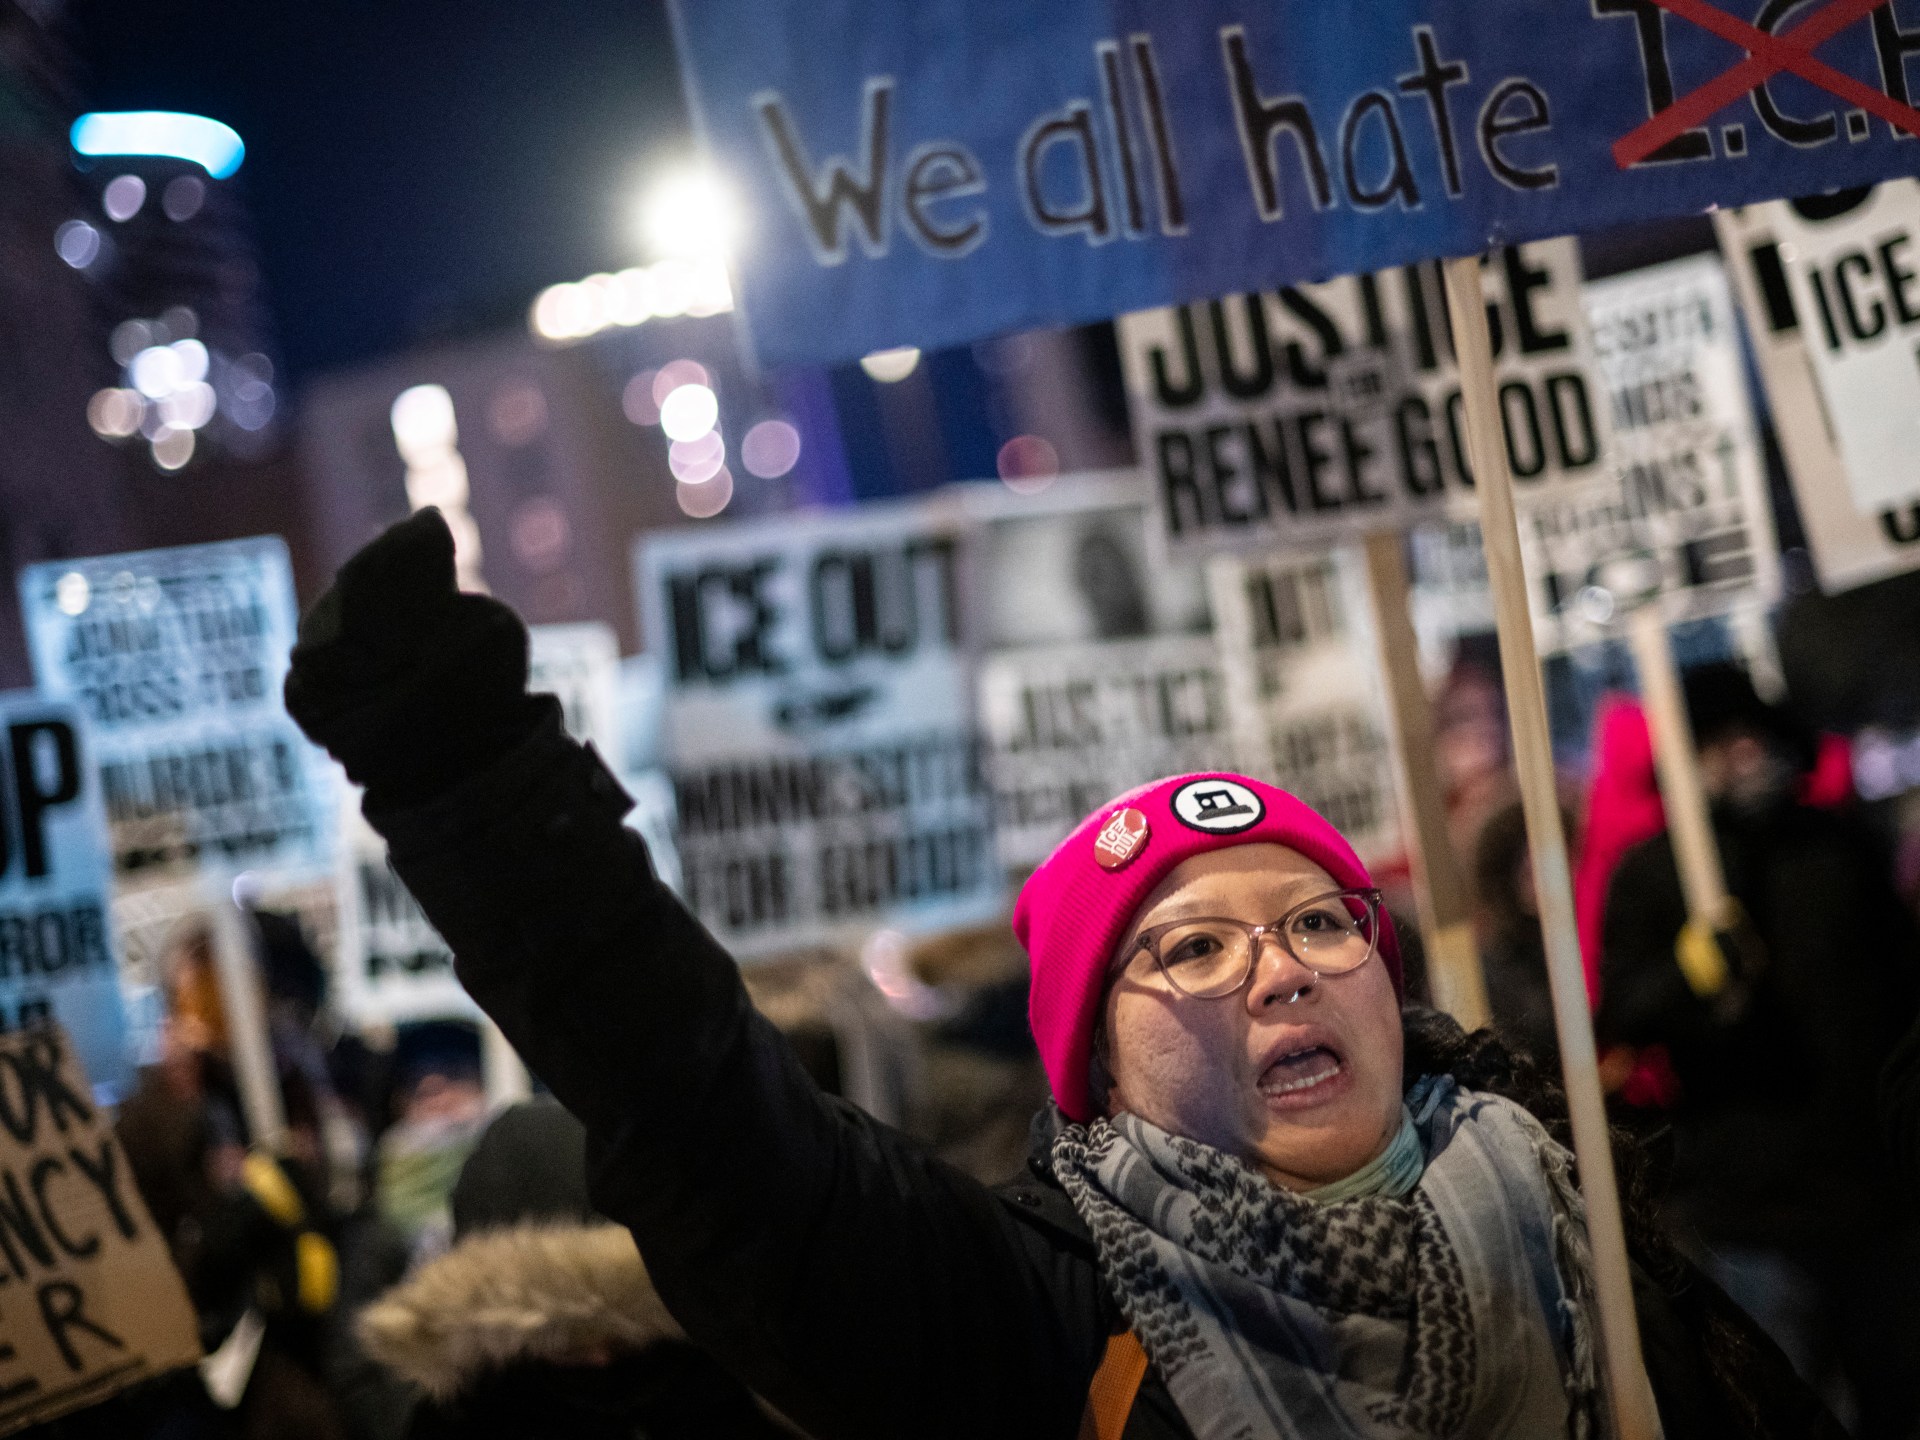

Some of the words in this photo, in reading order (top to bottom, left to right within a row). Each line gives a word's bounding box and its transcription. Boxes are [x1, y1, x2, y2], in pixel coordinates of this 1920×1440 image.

[750, 76, 988, 267] We
[1017, 34, 1190, 247] all
[1218, 23, 1558, 222] hate
[1159, 410, 1387, 538] RENEE
[1396, 371, 1600, 498] GOOD
[664, 556, 788, 684] ICE
[810, 535, 960, 664] OUT
[1098, 821, 1124, 849] ICE
[1114, 831, 1138, 857] OUT
